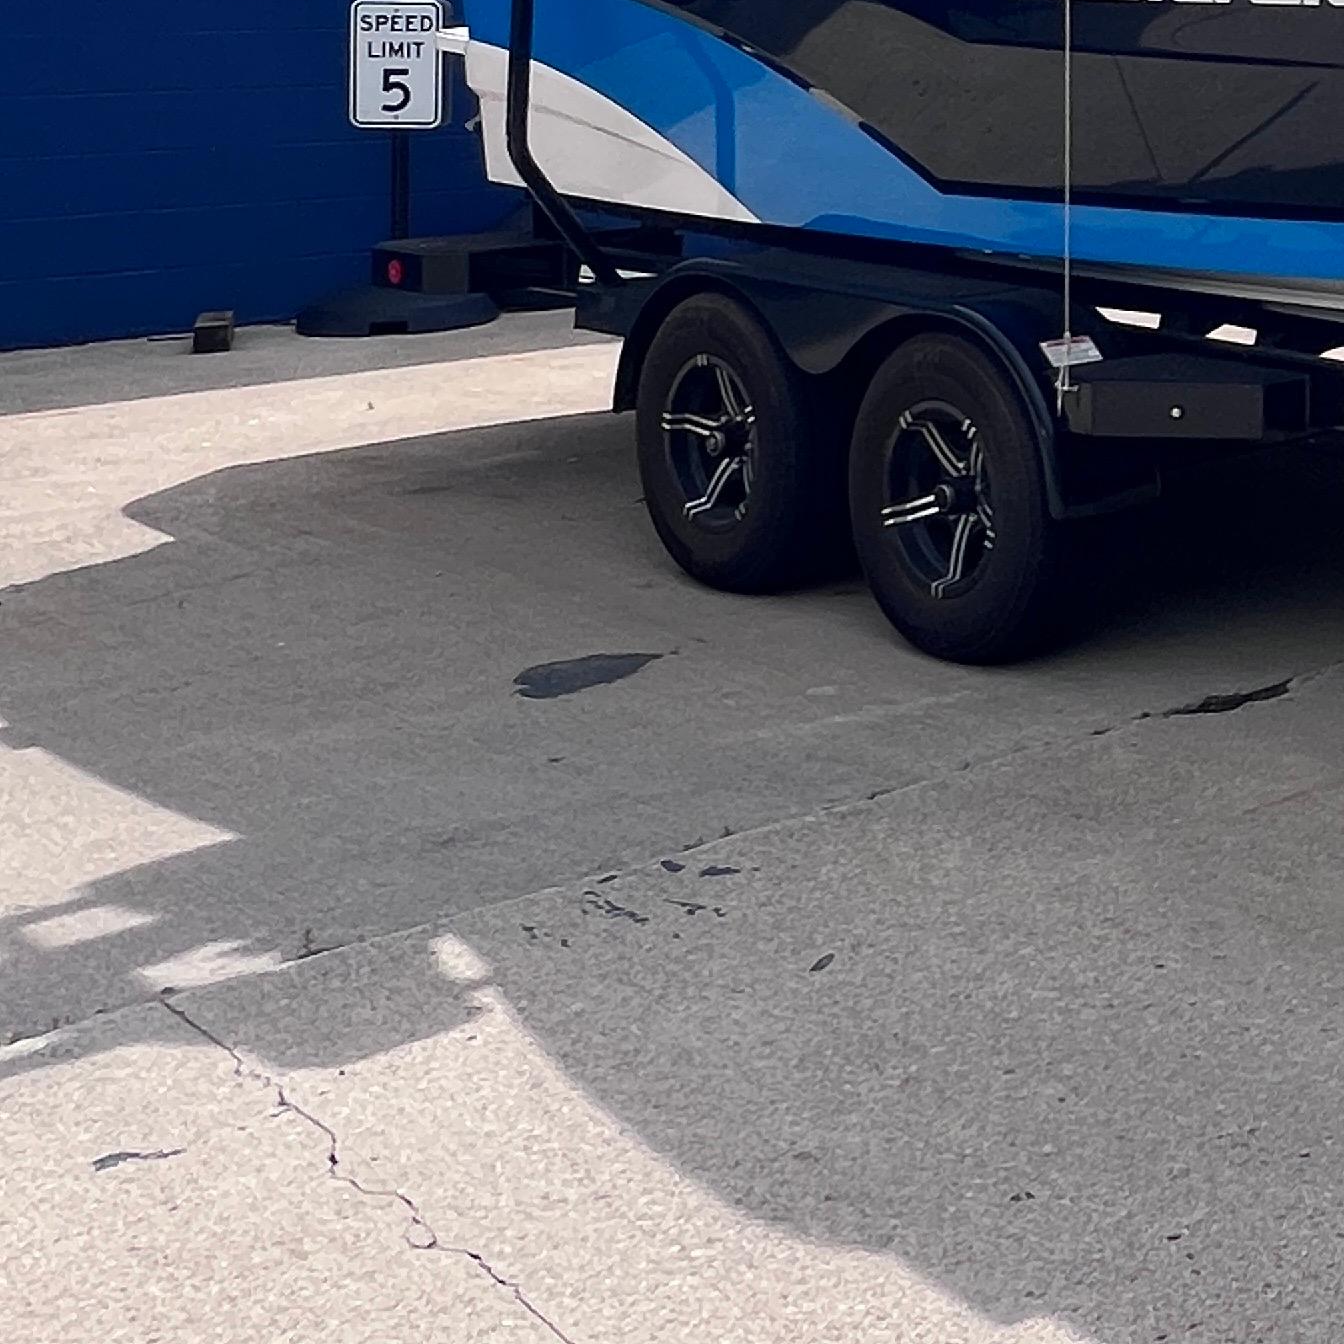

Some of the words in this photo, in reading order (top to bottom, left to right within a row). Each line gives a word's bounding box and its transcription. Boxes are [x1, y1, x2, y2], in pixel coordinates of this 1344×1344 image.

[360, 14, 434, 32] SPEED
[367, 41, 425, 58] LIMIT
[380, 68, 412, 113] 5
